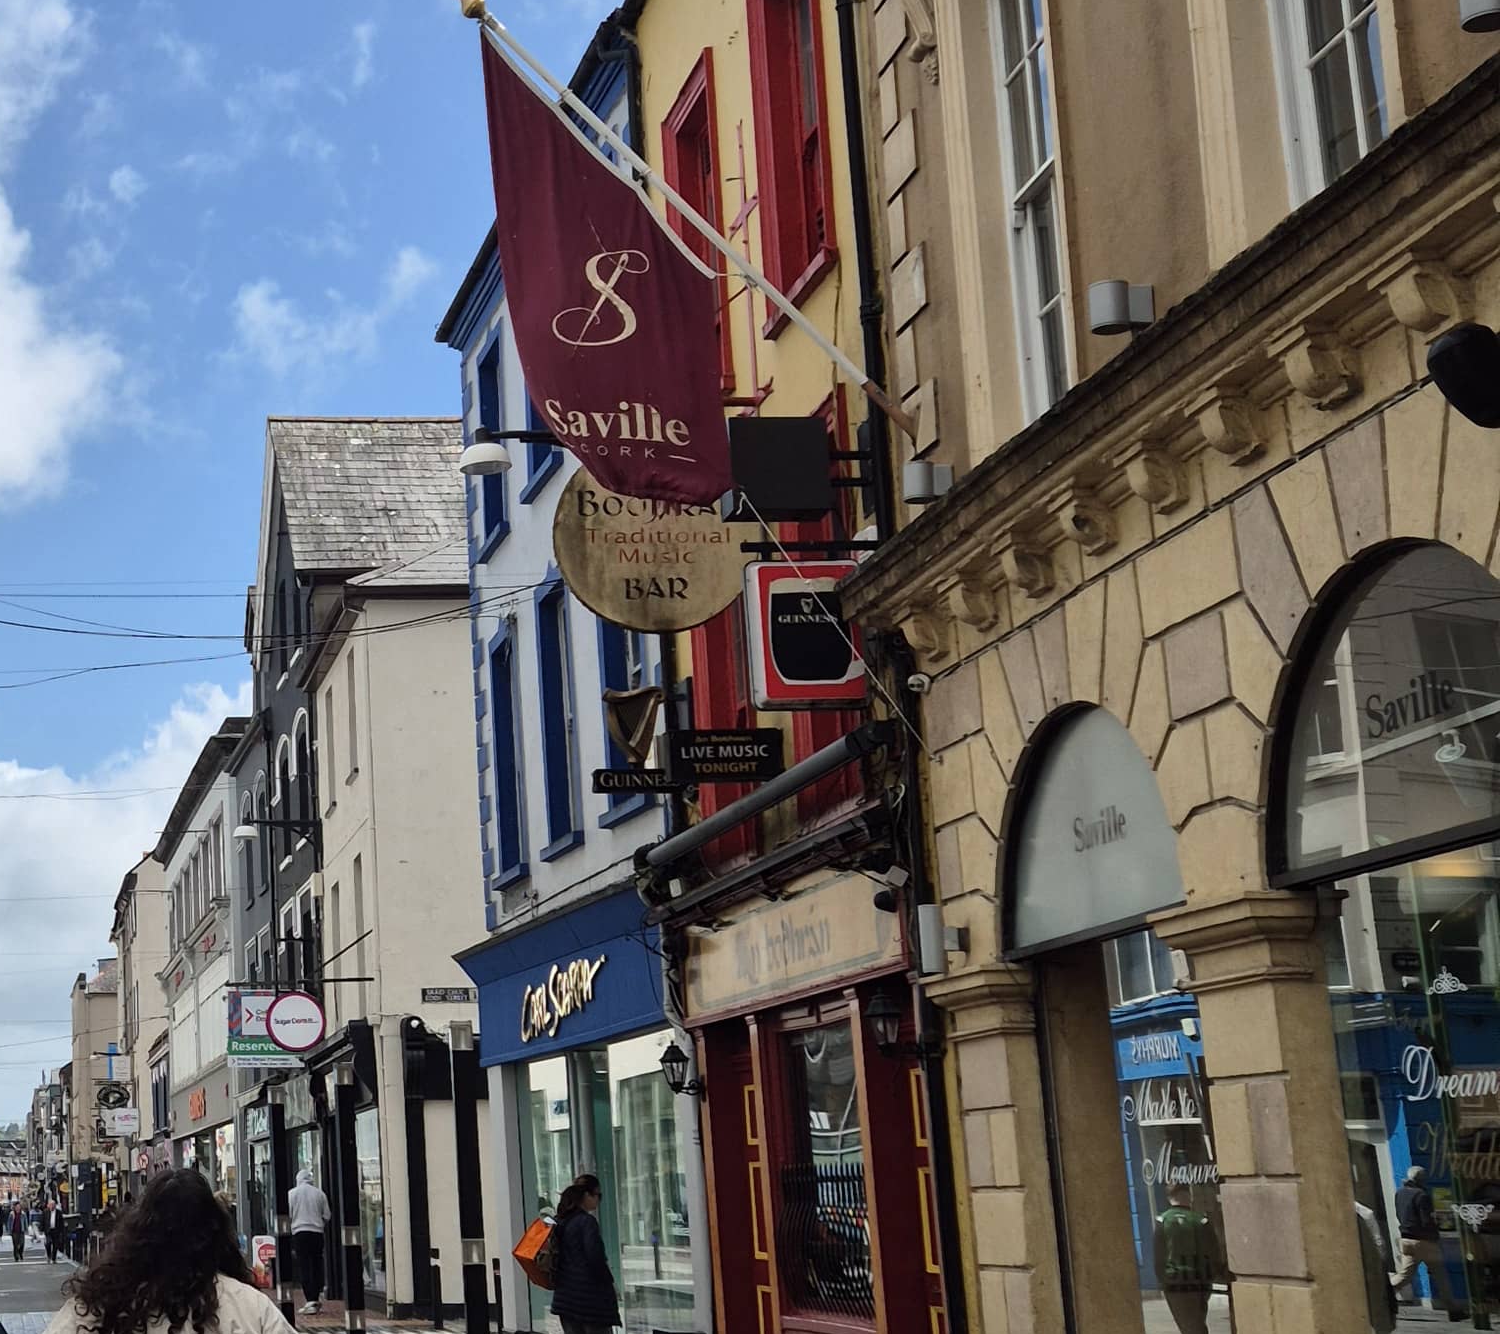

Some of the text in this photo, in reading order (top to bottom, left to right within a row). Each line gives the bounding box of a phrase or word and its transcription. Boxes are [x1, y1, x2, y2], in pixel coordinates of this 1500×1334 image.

[545, 398, 691, 447] Saville
[581, 443, 656, 459] CORK
[587, 527, 731, 544] Traditional
[619, 548, 697, 564] Music
[624, 577, 690, 601] BAR
[778, 614, 838, 624] GUINNESS
[1366, 670, 1453, 738] Saville
[680, 744, 769, 759] LIVE MUSIC
[693, 762, 758, 774] TONIGHT
[600, 772, 679, 787] GUINNE
[1402, 1045, 1499, 1101] Dream
[1124, 1079, 1177, 1122] Made
[1143, 1141, 1220, 1186] Measure
